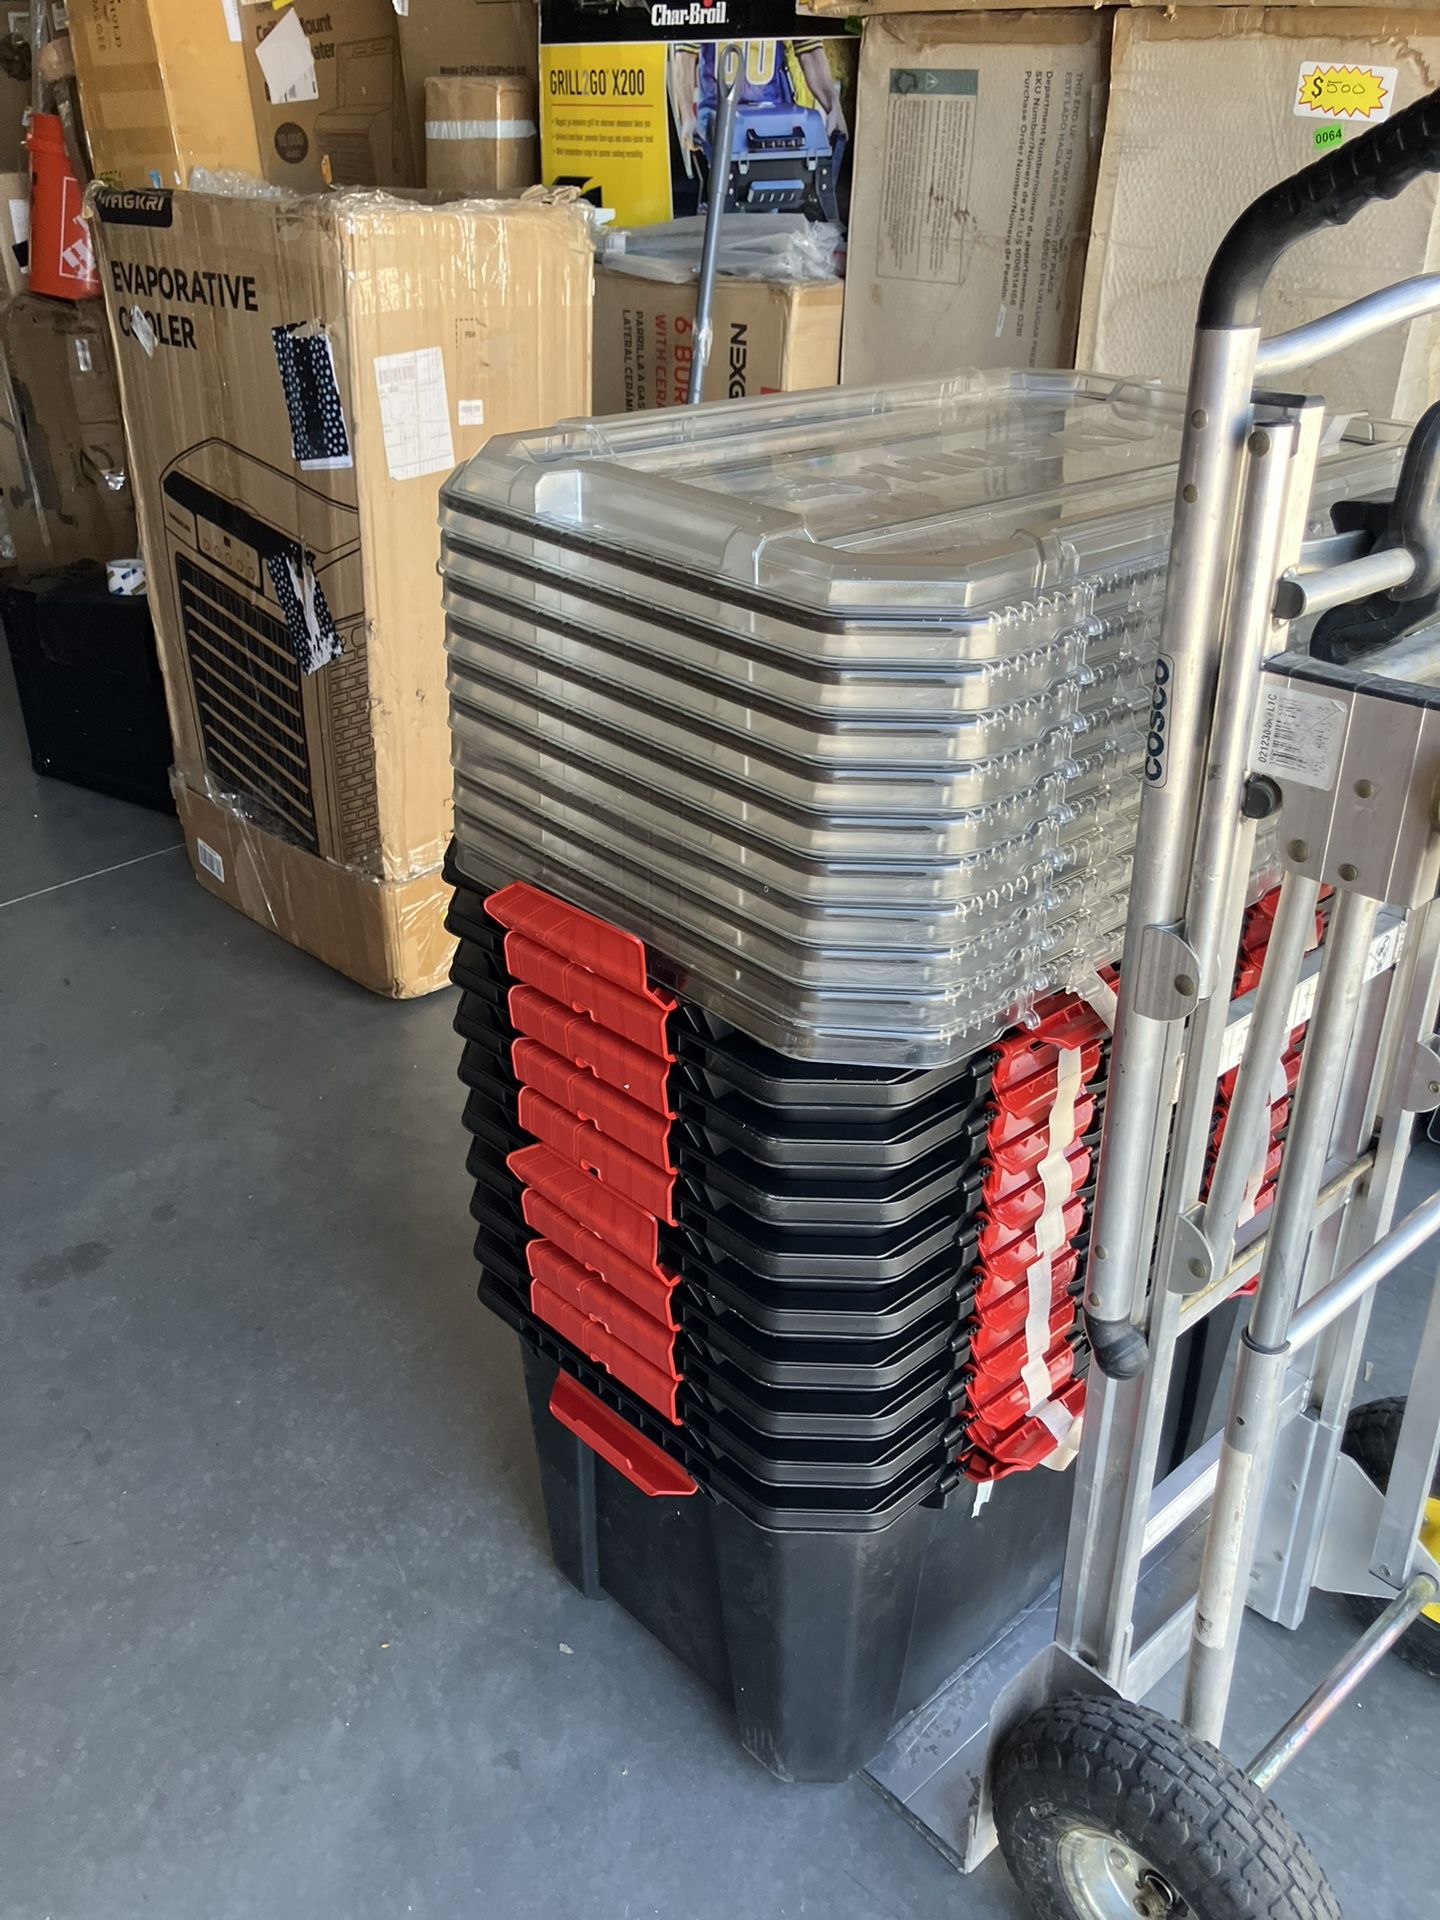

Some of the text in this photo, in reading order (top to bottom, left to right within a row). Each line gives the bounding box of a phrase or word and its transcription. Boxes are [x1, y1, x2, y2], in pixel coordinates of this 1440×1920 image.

[611, 69, 645, 96] X200
[1034, 70, 1043, 94] SKU
[1064, 72, 1073, 97] ESTE
[1074, 72, 1083, 97] THIS
[1021, 71, 1032, 122] Purchase
[1040, 71, 1053, 134] Department
[1071, 99, 1080, 122] END
[1060, 101, 1069, 130] LADO
[1017, 124, 1028, 156] Order
[1023, 98, 1040, 188] Number/Número
[1315, 128, 1342, 144] 0064
[1021, 191, 1028, 204] de
[1026, 225, 1034, 238] de
[1004, 248, 1012, 261] de
[110, 260, 259, 312] EVAPORATIVE
[622, 309, 633, 363] LATERAL
[655, 314, 667, 361] WITH
[635, 311, 646, 408] PARRILLA A GAS
